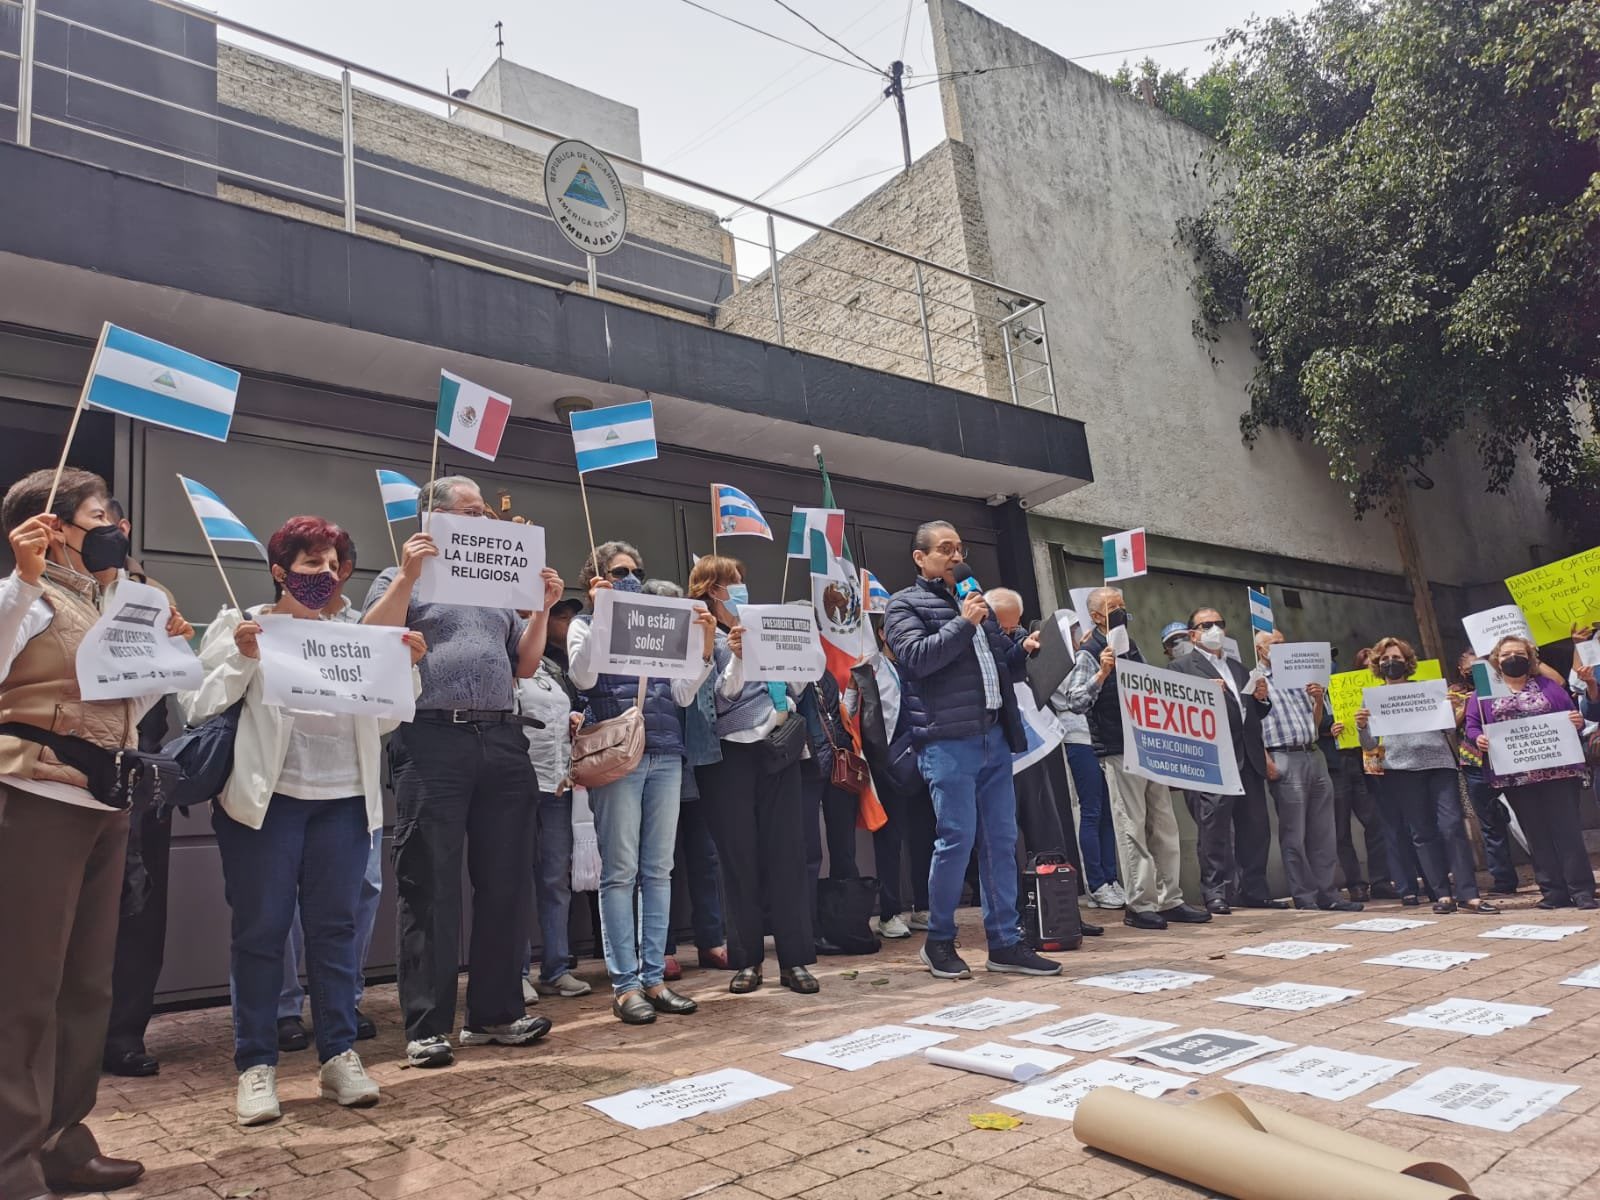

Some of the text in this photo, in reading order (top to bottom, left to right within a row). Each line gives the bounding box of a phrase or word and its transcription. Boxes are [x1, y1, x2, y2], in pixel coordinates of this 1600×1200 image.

[576, 152, 588, 160] DE
[590, 156, 621, 202] NICARAGUA
[594, 210, 622, 228] CENTRAL
[560, 216, 618, 246] EMBAJADA
[452, 533, 524, 552] RESPETO A
[444, 548, 528, 568] LA LIBERTAD
[452, 566, 520, 583] RELIGIOSA
[1508, 569, 1552, 590] DANIEL
[1514, 578, 1566, 600] DICTADOR
[1570, 573, 1577, 583] Y
[1551, 582, 1590, 600] PUEBLO
[628, 610, 676, 630] ¡No están
[302, 639, 371, 660] ¡No están
[634, 633, 665, 651] solos!
[320, 664, 362, 682] solos!
[1164, 681, 1216, 706] RESCATE
[1388, 692, 1425, 702] HERMANOS
[1124, 690, 1216, 741] MÉXICO
[1510, 726, 1530, 734] ALTO
[1142, 734, 1204, 757] #MEXICOUNIDO
[1531, 737, 1560, 746] IGLESIA
[1514, 752, 1562, 764] OPOSITORES
[1170, 764, 1178, 772] DE
[1180, 763, 1205, 778] MÉXICO
